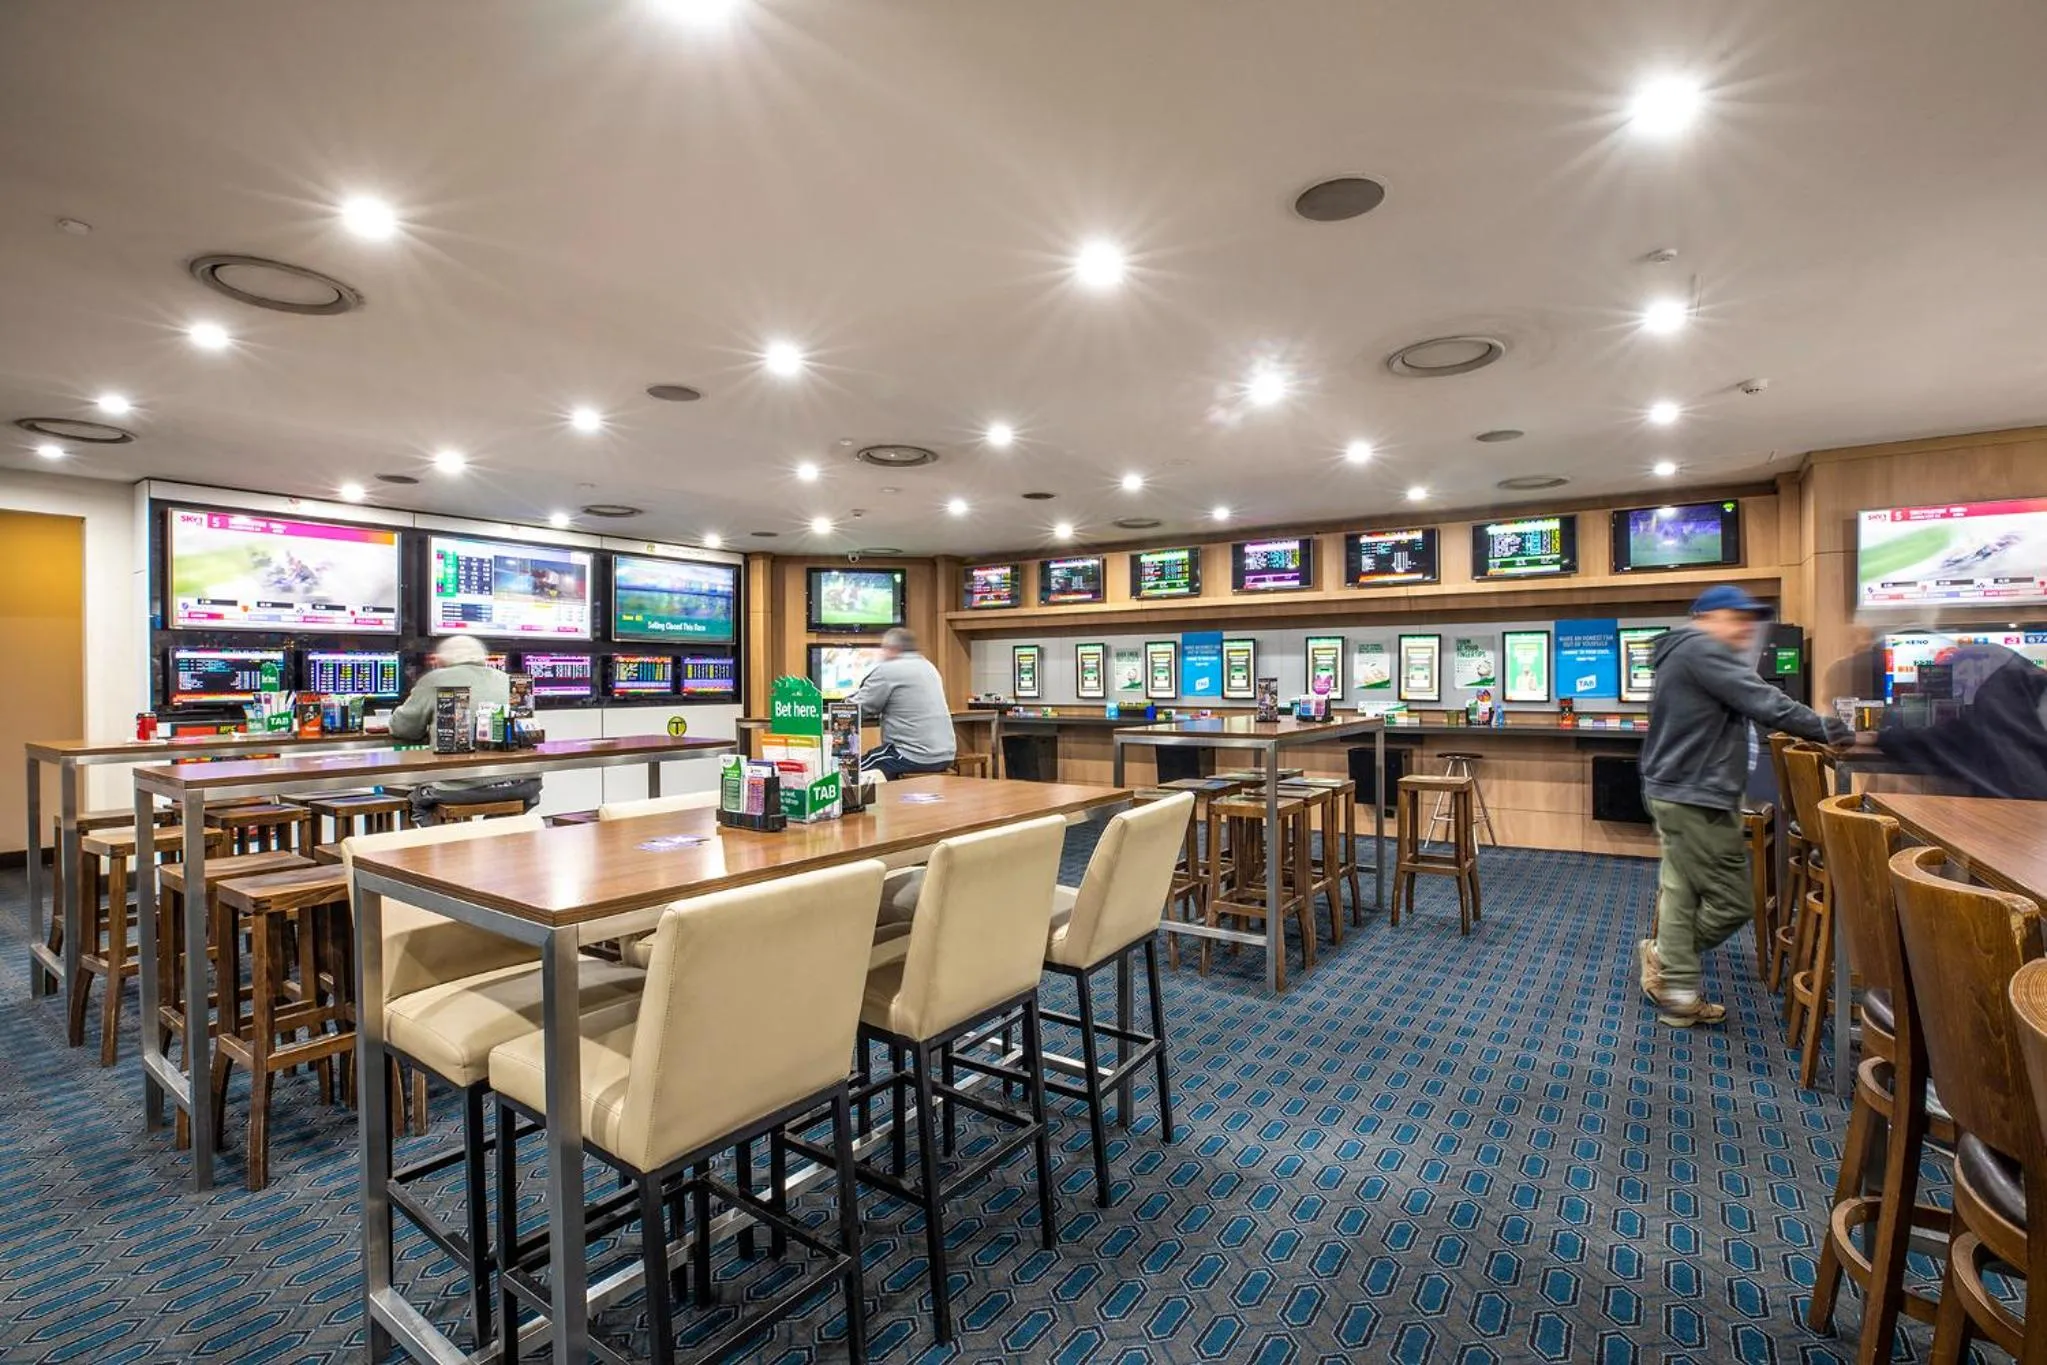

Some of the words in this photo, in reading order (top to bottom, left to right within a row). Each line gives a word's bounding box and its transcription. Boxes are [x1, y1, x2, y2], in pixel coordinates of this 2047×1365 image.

[647, 621, 665, 631] Selling
[666, 622, 682, 630] Closed
[774, 700, 792, 717] Bet
[793, 701, 820, 718] here.
[270, 716, 289, 727] TAB
[813, 784, 837, 801] TAB
